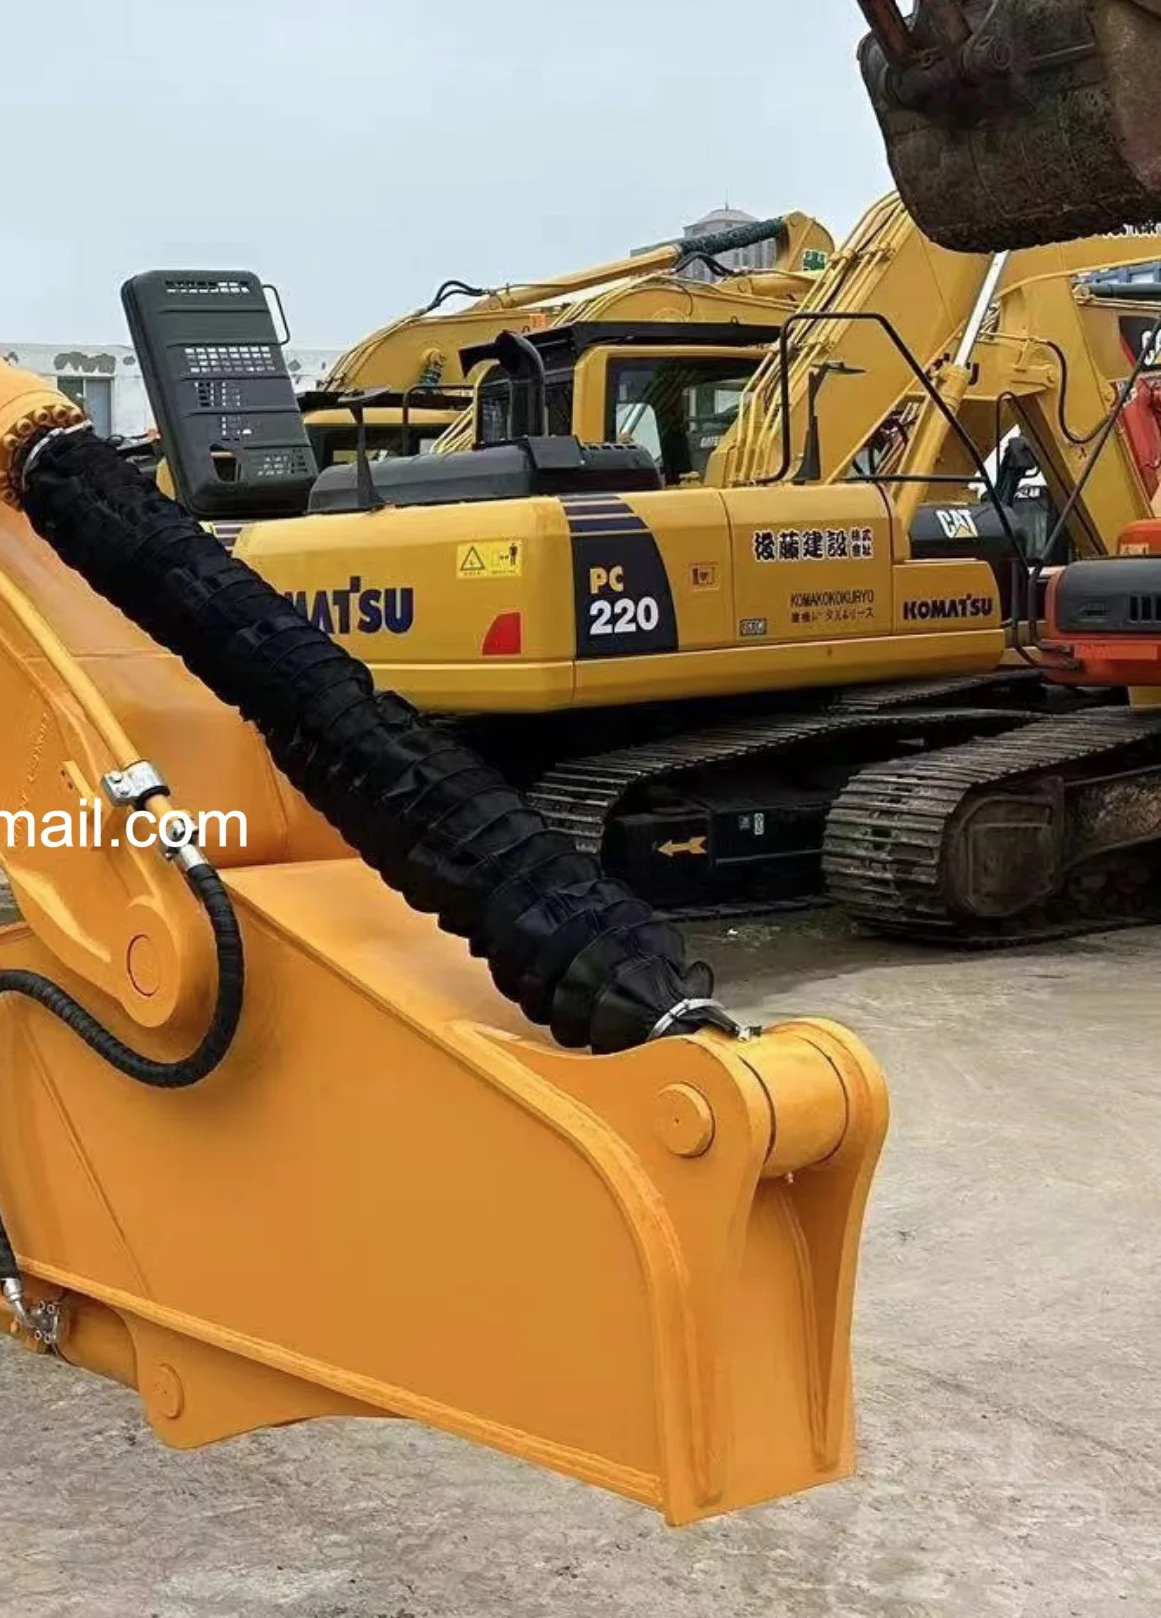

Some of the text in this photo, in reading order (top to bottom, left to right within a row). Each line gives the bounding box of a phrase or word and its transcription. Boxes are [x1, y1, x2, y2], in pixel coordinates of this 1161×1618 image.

[935, 509, 978, 538] CAT
[589, 565, 624, 594] PC
[284, 575, 414, 634] ATSU
[589, 596, 659, 635] 220
[903, 593, 993, 620] KOMATSU
